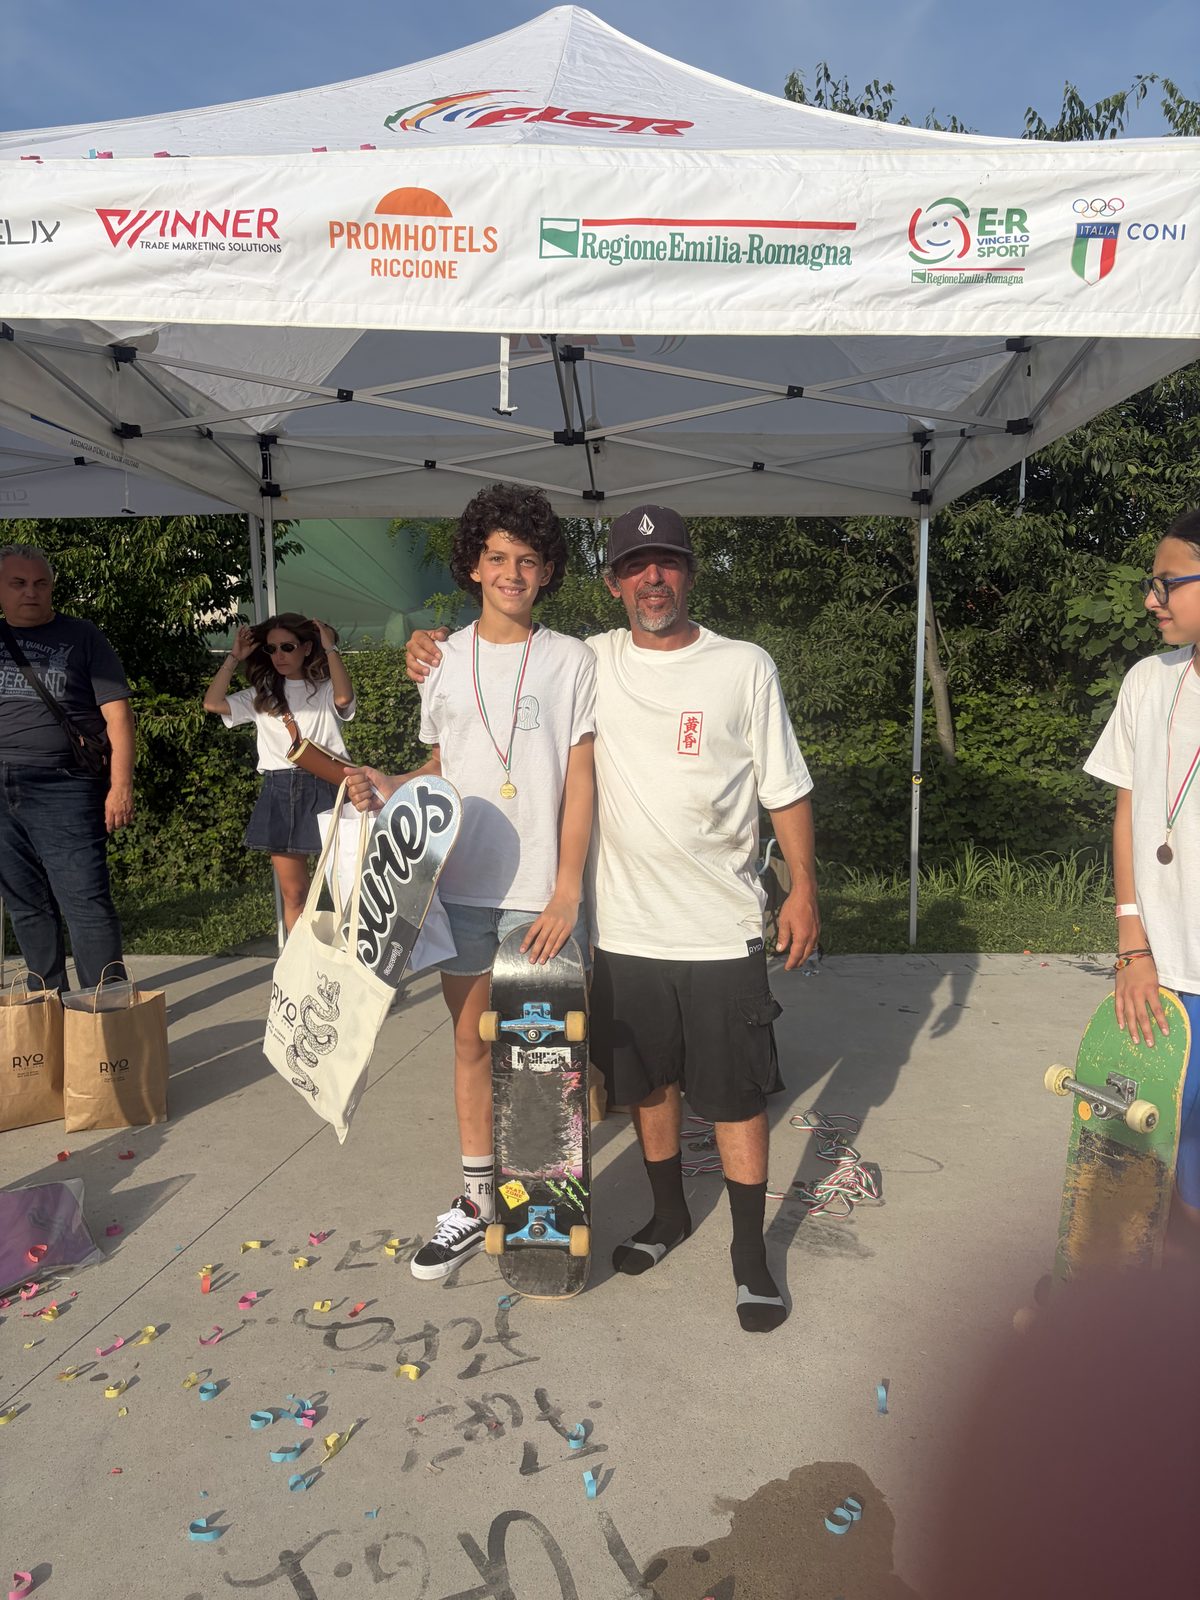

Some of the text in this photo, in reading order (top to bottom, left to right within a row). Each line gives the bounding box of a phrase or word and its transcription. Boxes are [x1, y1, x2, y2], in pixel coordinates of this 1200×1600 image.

[95, 207, 280, 249] WINNER
[1080, 225, 1116, 236] ITALIA
[1127, 223, 1186, 241] CONI
[329, 221, 499, 254] PROMHOTELS
[976, 234, 1030, 246] VINCE LO
[140, 240, 282, 254] TRADE MARKETING SOLUTIONS
[977, 245, 1030, 258] SPORT
[370, 258, 458, 280] RICCIONE
[26, 641, 57, 655] QUALITY
[271, 982, 298, 1028] RYO
[12, 1053, 45, 1069] RYO
[99, 1058, 129, 1074] RYO
[505, 1185, 525, 1195] SKATE
[506, 1189, 523, 1198] ZONE
